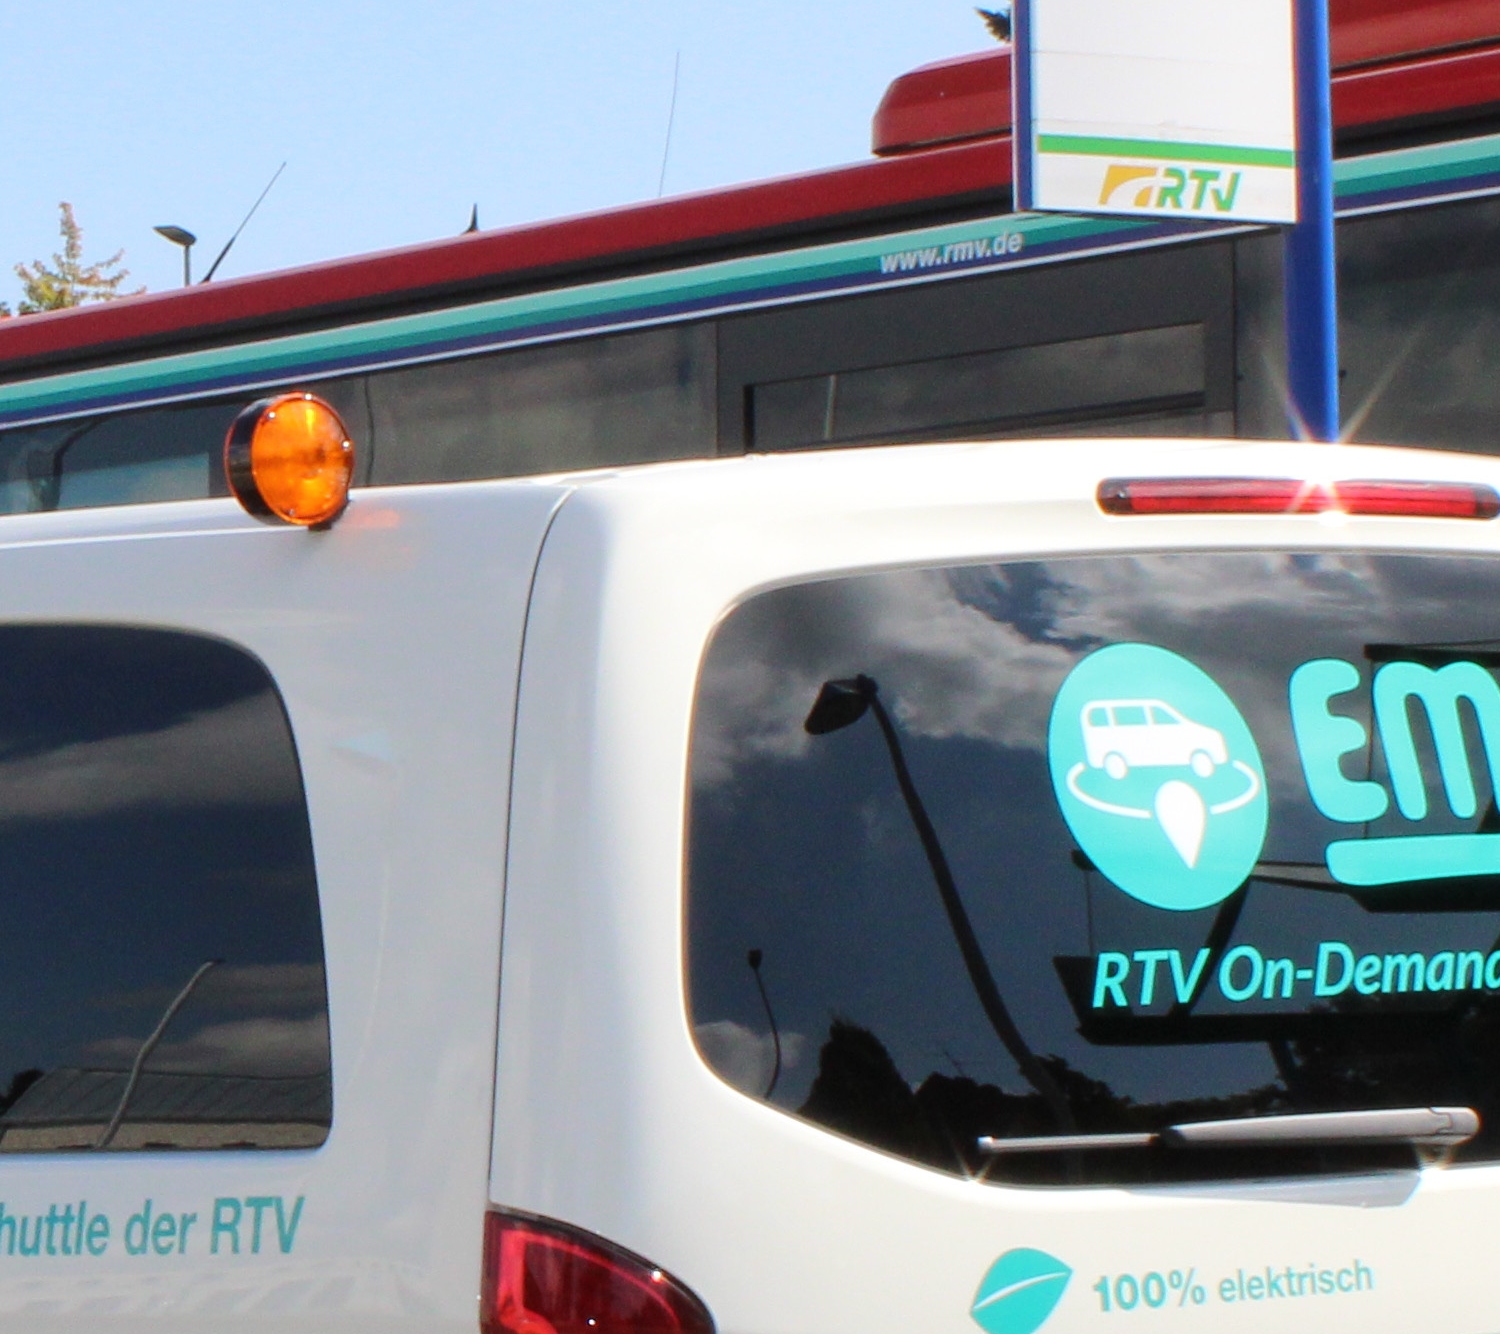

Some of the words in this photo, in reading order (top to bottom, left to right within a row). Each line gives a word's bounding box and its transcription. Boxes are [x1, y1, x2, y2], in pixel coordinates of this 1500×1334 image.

[1155, 166, 1241, 212] RTV
[880, 230, 1025, 274] www.rmv.de
[1092, 947, 1211, 1009] RTV
[123, 1199, 198, 1256] der
[209, 1195, 306, 1256] RTV
[1093, 1267, 1207, 1312] 100%
[1217, 1258, 1376, 1303] elektrisch
